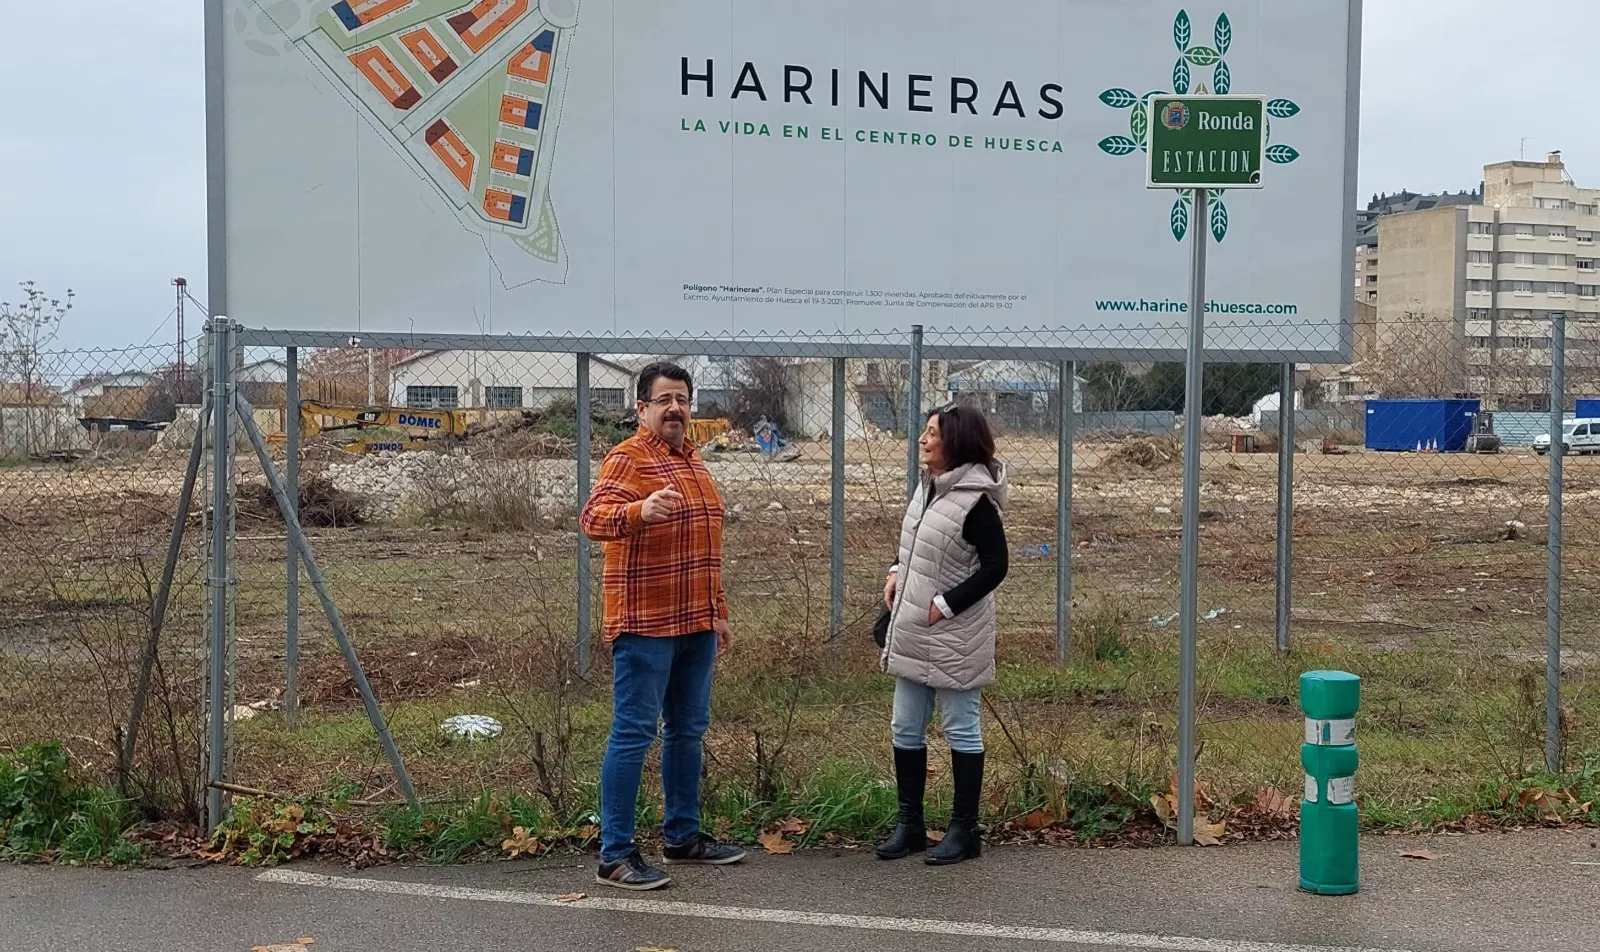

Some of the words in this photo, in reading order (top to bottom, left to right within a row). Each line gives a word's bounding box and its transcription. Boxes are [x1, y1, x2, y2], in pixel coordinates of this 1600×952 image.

[680, 56, 1064, 120] HARINERAS
[1198, 111, 1254, 130] Ronda
[681, 118, 706, 132] LA
[718, 120, 771, 137] VIDA
[783, 125, 809, 139] EN
[821, 127, 844, 141] EL
[855, 129, 937, 147] CENTRO
[949, 134, 974, 149] DE
[984, 136, 1064, 153] HUESCA
[1163, 150, 1251, 173] ESTACION
[683, 284, 718, 293] Polígono
[766, 286, 783, 294] Plan
[784, 287, 814, 296] Especial
[815, 290, 831, 298] para
[919, 291, 953, 300] Aprobado
[711, 294, 764, 303] Ayuntamiento
[776, 296, 803, 304] Huesca
[1095, 298, 1298, 315] www.harineshuesca.com
[398, 414, 442, 429] DOMEC
